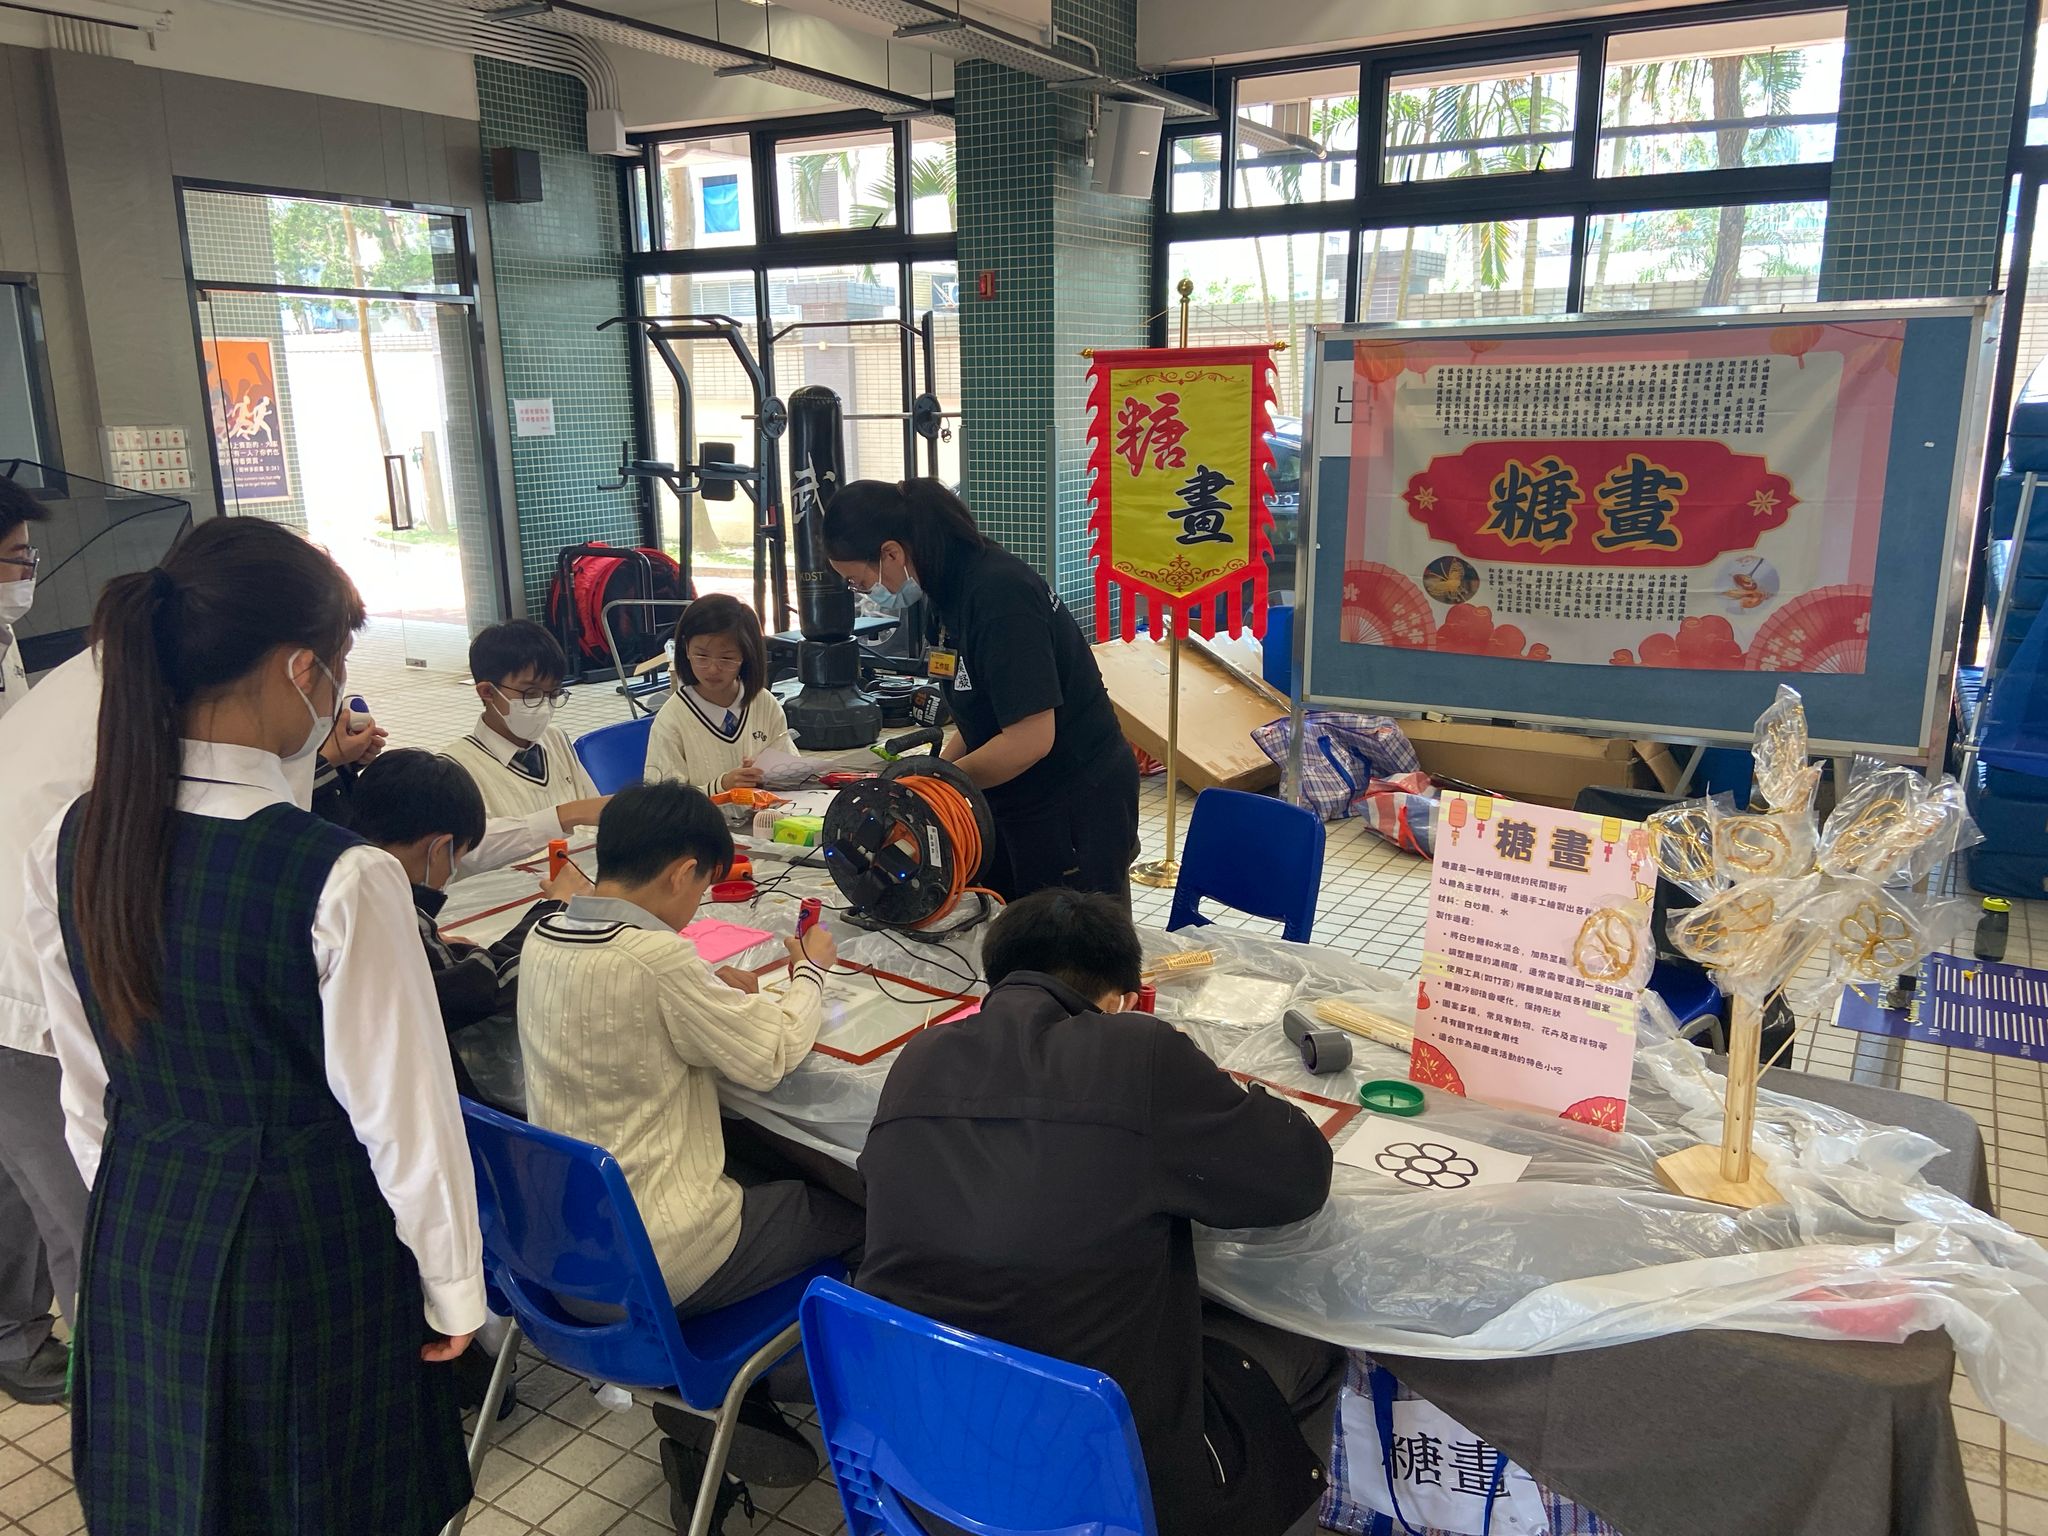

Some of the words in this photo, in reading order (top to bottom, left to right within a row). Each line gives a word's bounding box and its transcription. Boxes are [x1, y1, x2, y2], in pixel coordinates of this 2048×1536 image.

[1115, 391, 1235, 545] 糖畫
[1487, 457, 1684, 548] 糖畫
[1441, 860, 1568, 894] 糖畫是一種中國傳統的民間藝術
[1495, 817, 1592, 873] 糖畫
[1382, 1432, 1511, 1498] 糖畫
